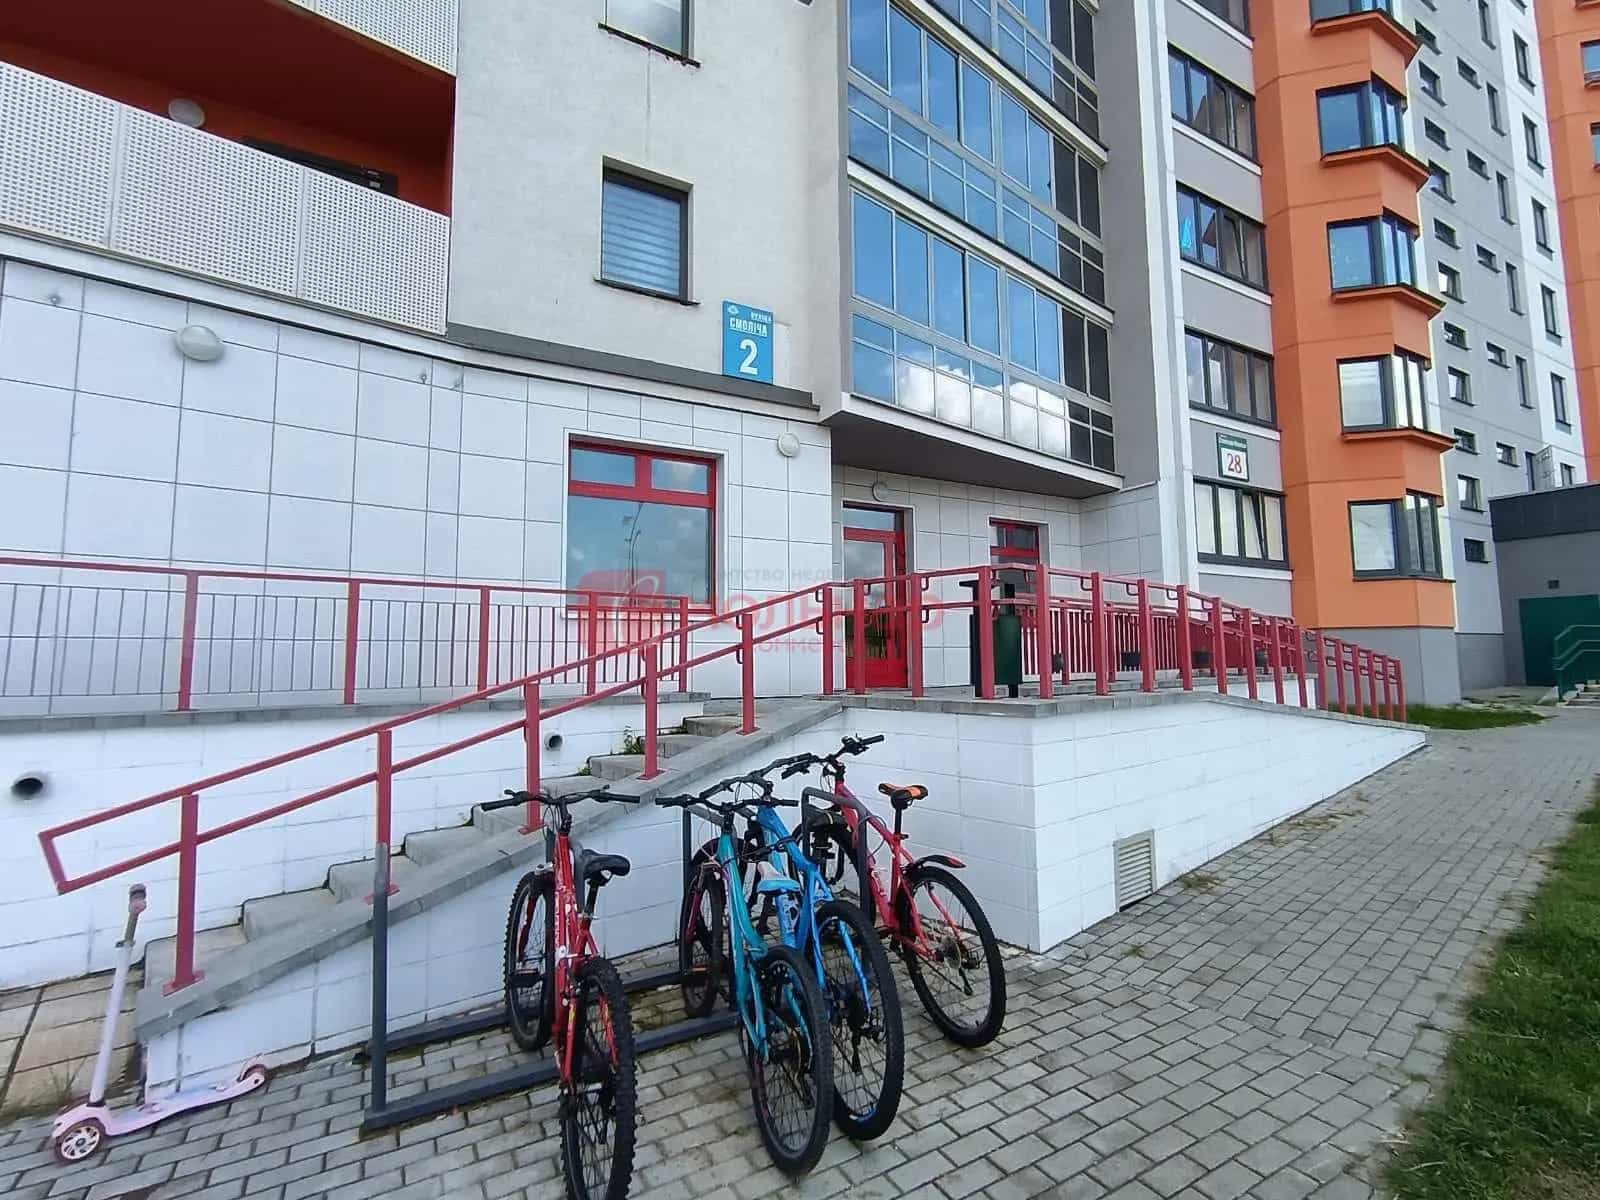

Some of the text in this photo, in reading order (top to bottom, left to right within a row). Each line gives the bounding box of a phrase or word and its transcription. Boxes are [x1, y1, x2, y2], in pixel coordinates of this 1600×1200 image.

[729, 317, 768, 337] СМОЛІЧА
[740, 338, 758, 375] 2
[1227, 453, 1242, 474] 28
